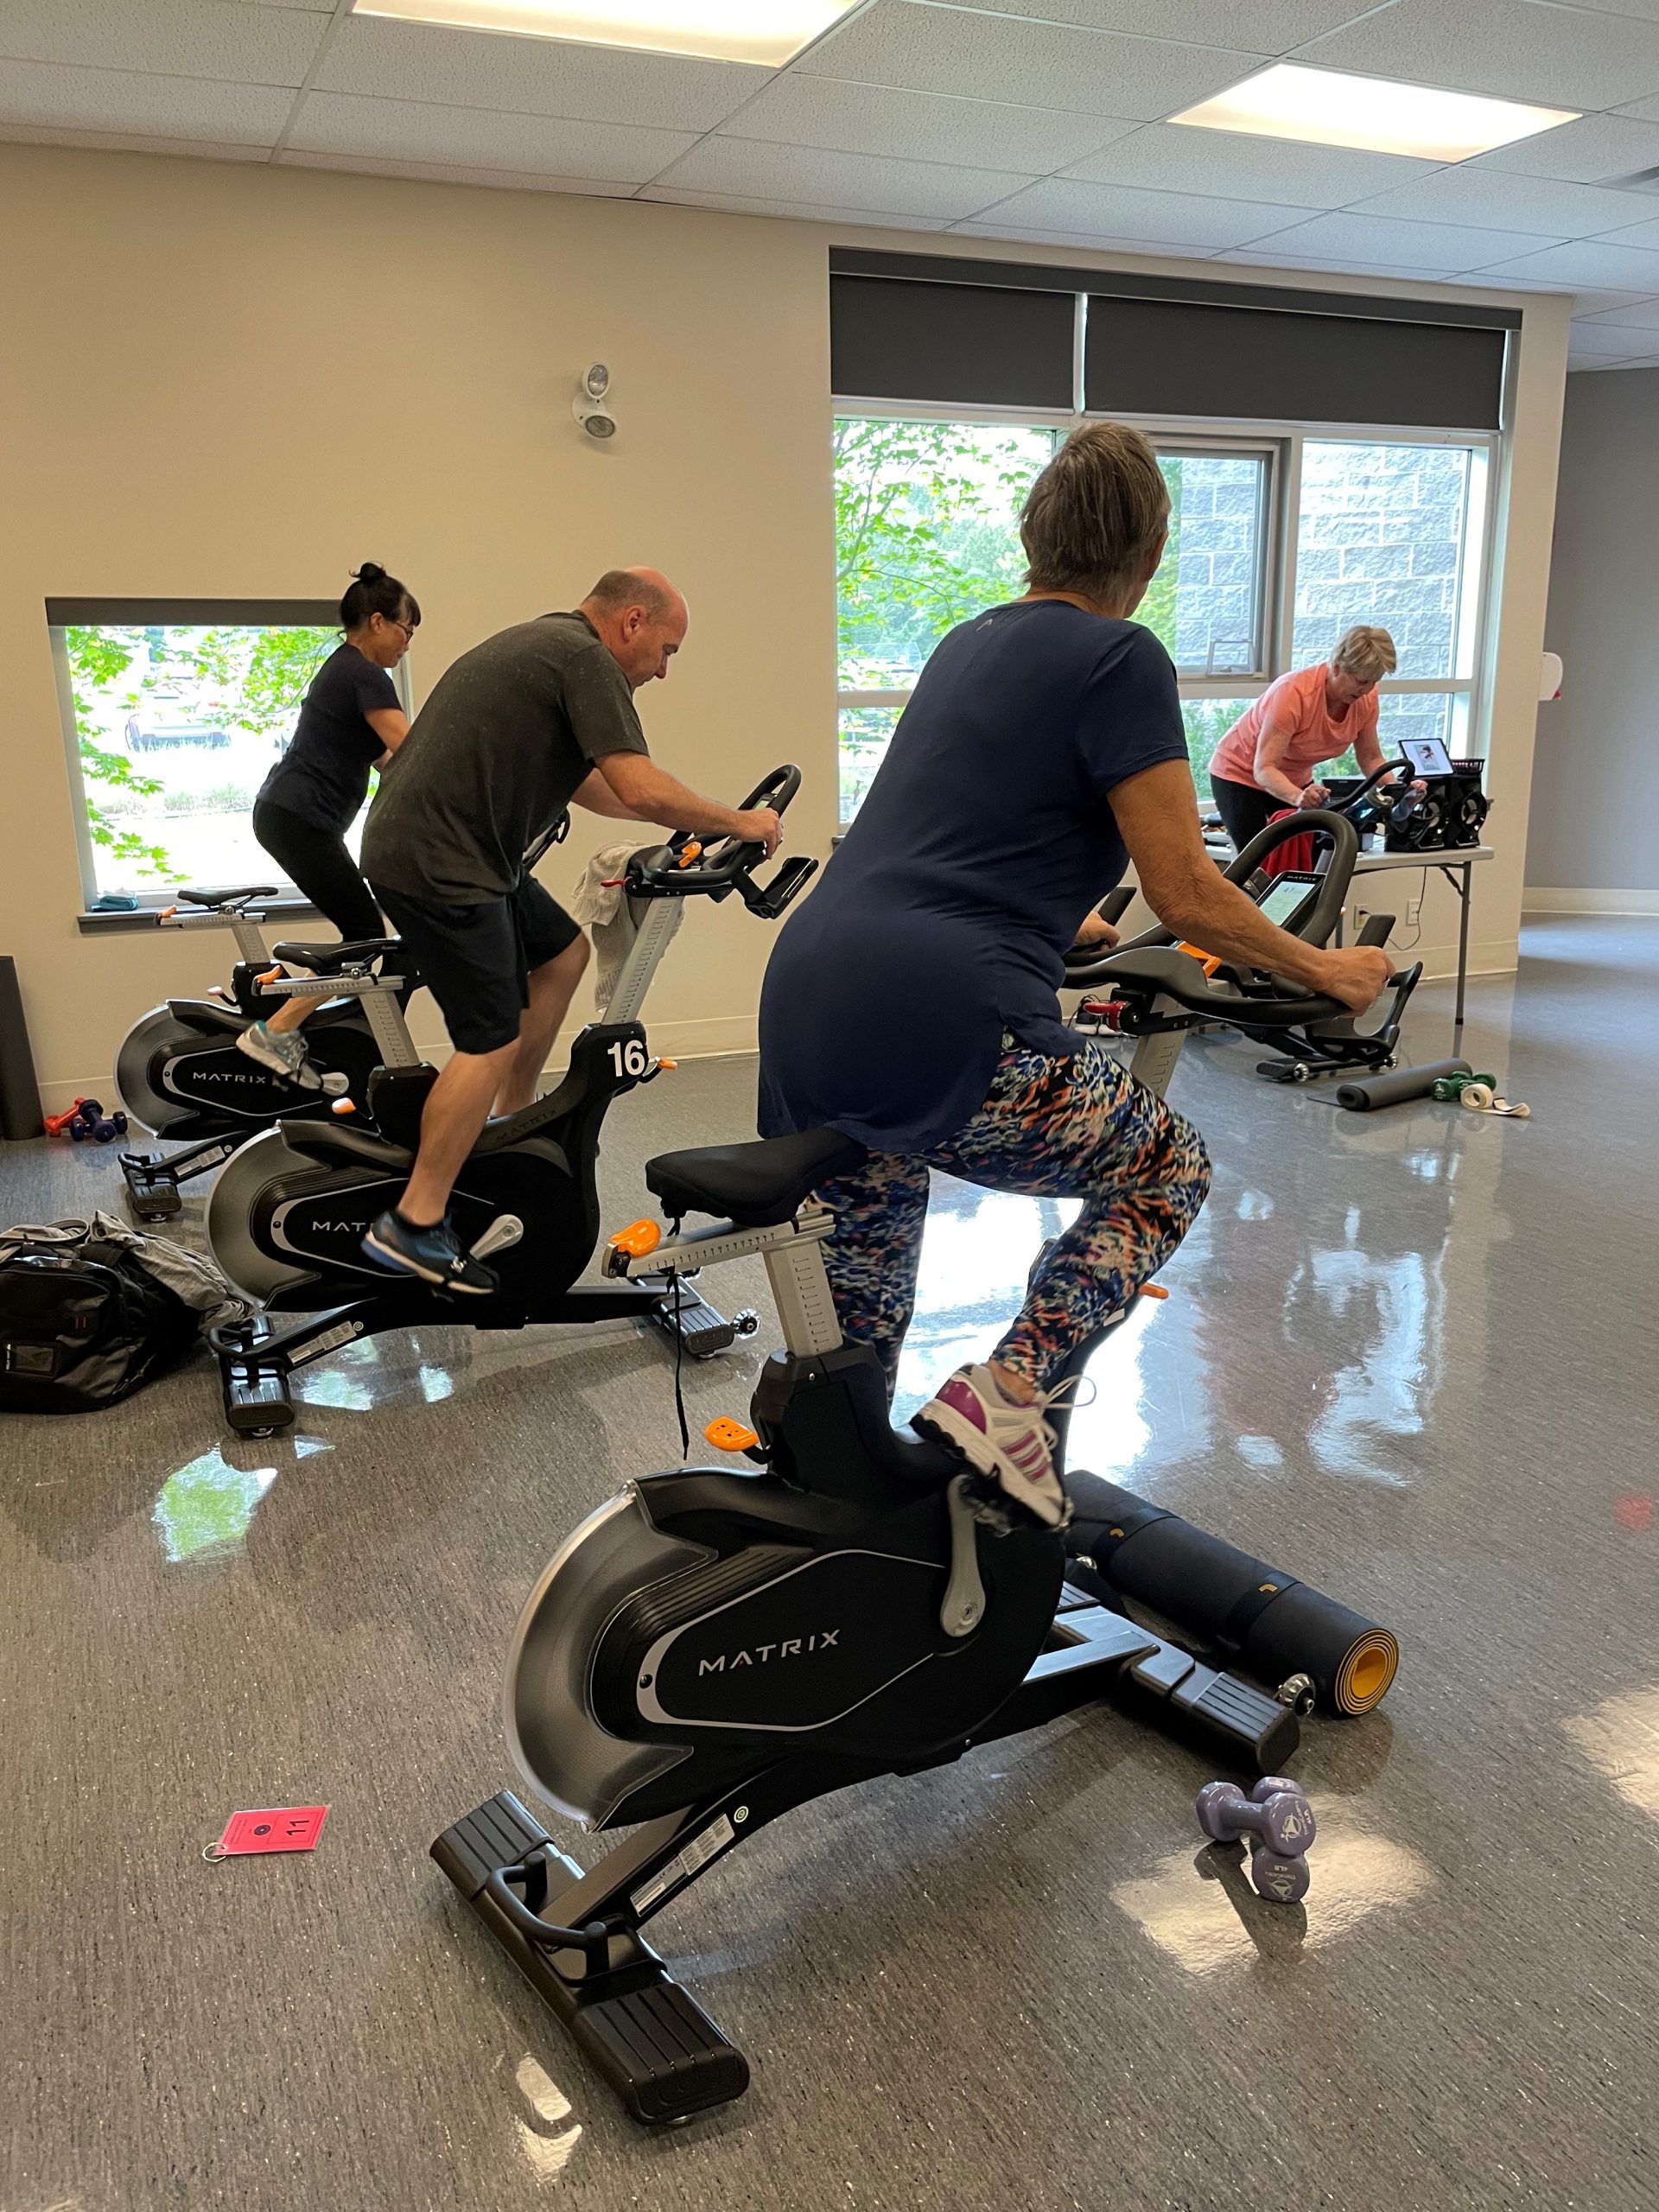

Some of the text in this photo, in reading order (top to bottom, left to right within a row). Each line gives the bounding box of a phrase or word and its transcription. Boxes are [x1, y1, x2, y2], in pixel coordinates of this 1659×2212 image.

[607, 1039, 645, 1077] 16
[193, 1072, 266, 1084] MATRIX
[312, 1221, 373, 1232] MAT
[698, 1629, 841, 1676] MATRIX
[286, 1819, 310, 1836] 11
